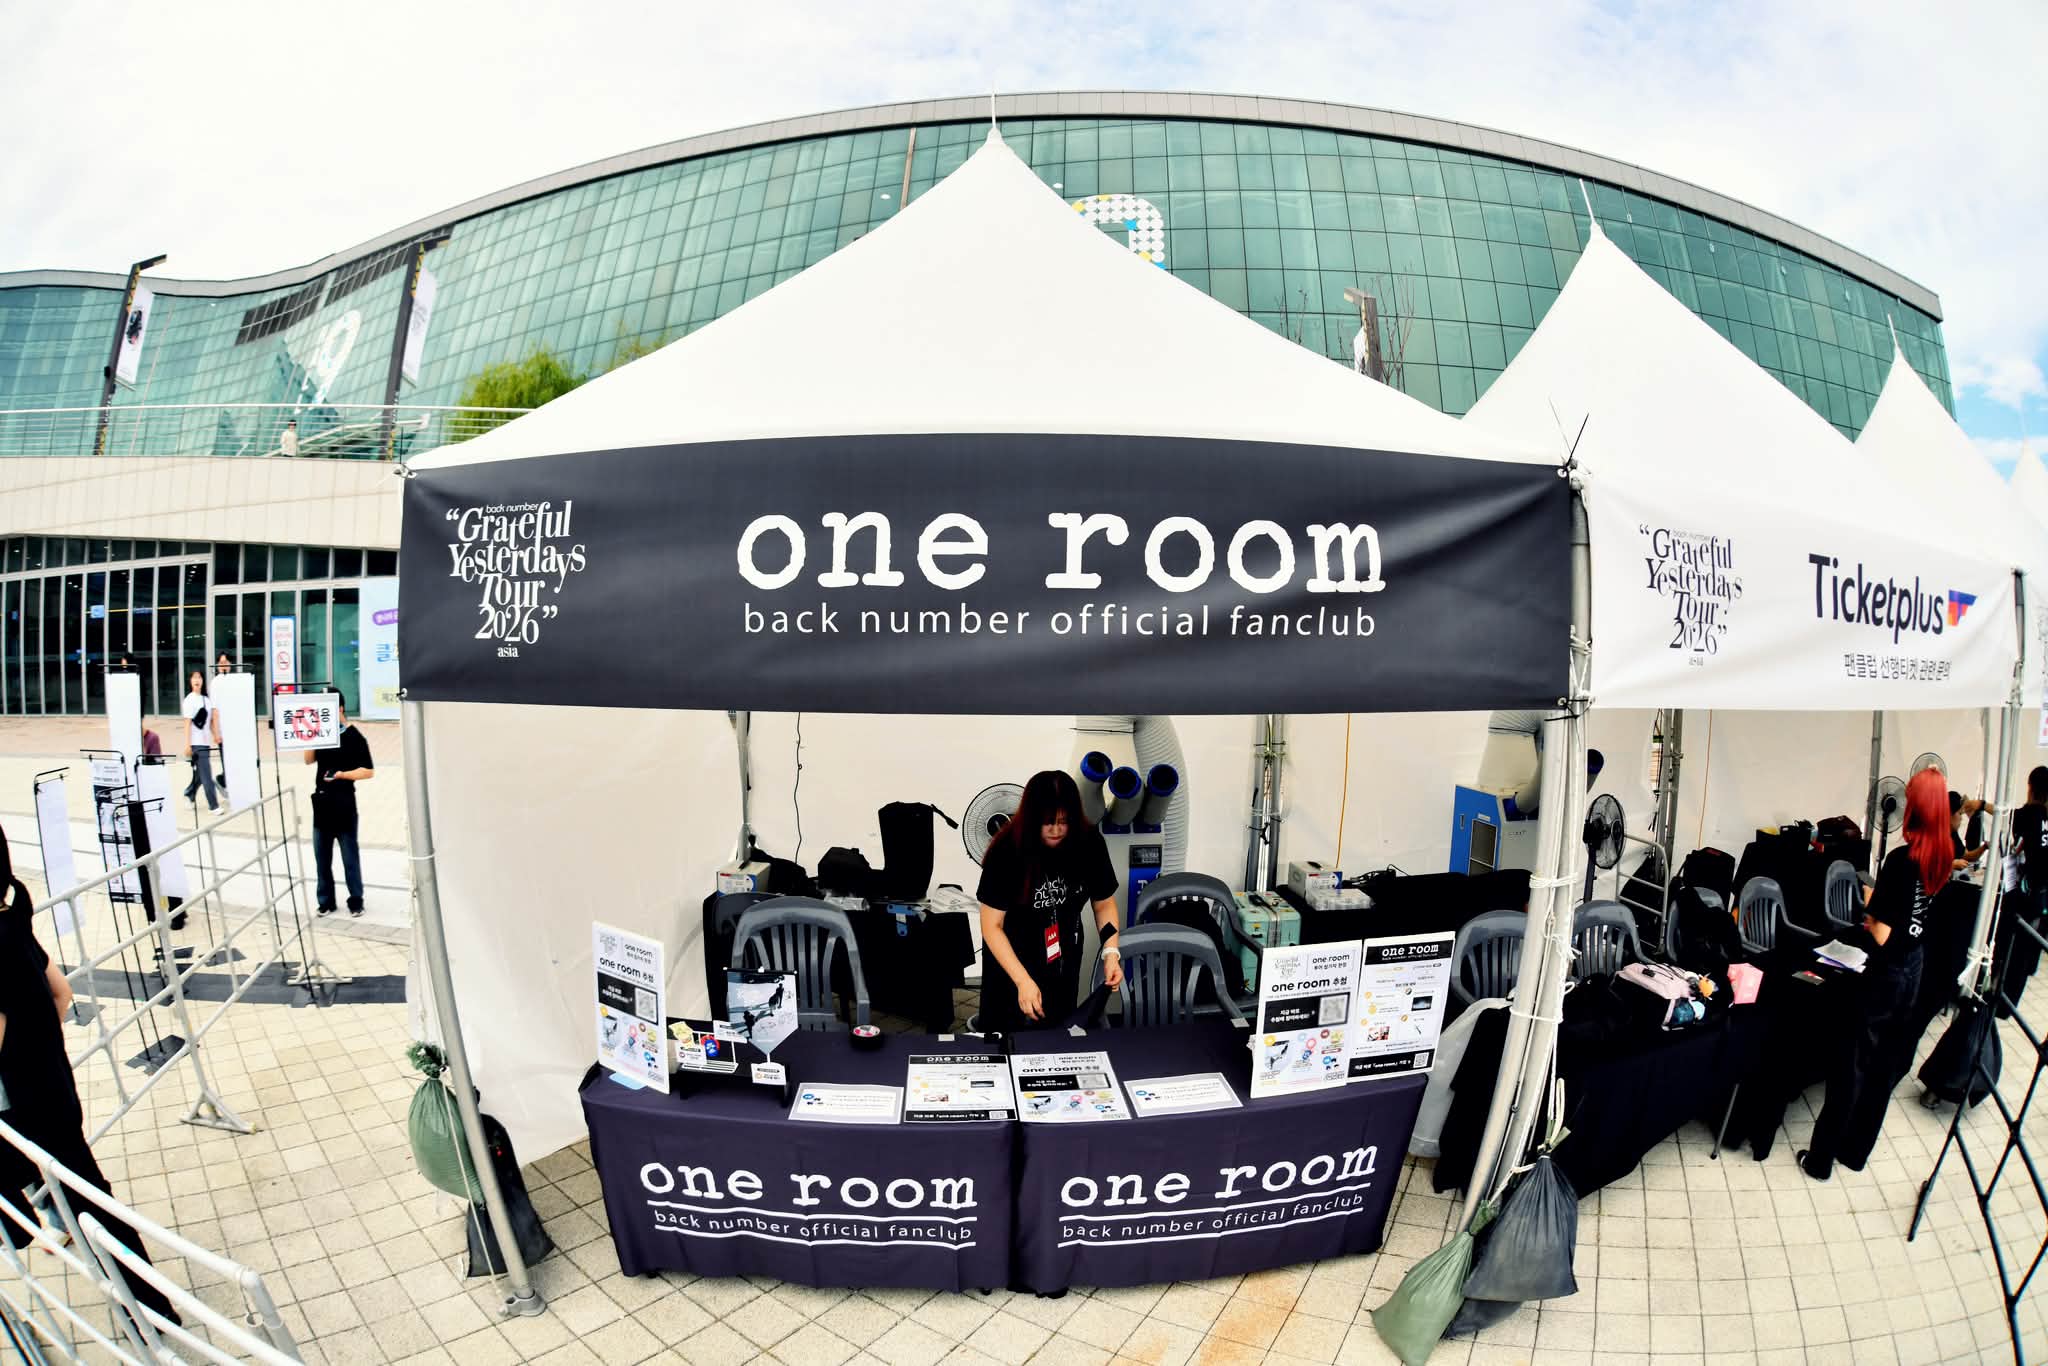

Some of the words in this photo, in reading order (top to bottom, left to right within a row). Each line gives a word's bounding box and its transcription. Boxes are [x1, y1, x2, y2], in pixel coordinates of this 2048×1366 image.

[486, 499, 505, 514] back
[505, 501, 540, 513] number
[448, 540, 586, 594] Yesterdays
[737, 511, 989, 591] one
[1045, 512, 1386, 594] room
[478, 572, 546, 608] Tour
[1645, 557, 1743, 614] Yesterdays
[1808, 553, 1945, 645] Ticketplus
[744, 602, 840, 633] back
[861, 602, 1030, 634] number
[1050, 603, 1209, 636] official
[1230, 604, 1375, 637] fanclub
[1672, 590, 1719, 625] Tour
[497, 643, 519, 657] asia
[1844, 653, 1878, 680] 팬클럽
[283, 730, 304, 740] EXIT
[306, 728, 332, 738] ONLY
[1328, 954, 1350, 962] room
[1381, 946, 1405, 957] one
[1407, 943, 1439, 955] room
[600, 957, 616, 969] one
[616, 963, 641, 979] room
[1271, 982, 1295, 993] one
[1297, 978, 1331, 990] room
[639, 1162, 763, 1201] one
[790, 1173, 978, 1210] room
[1060, 1172, 1191, 1208] one
[1214, 1145, 1378, 1199] room
[654, 1209, 701, 1228] back
[708, 1216, 790, 1234] number
[799, 1222, 878, 1239] official
[888, 1224, 972, 1241] fanclub
[1063, 1224, 1111, 1239] back
[1121, 1219, 1204, 1236] number
[1212, 1207, 1285, 1229] official
[1292, 1193, 1363, 1217] fanclub
